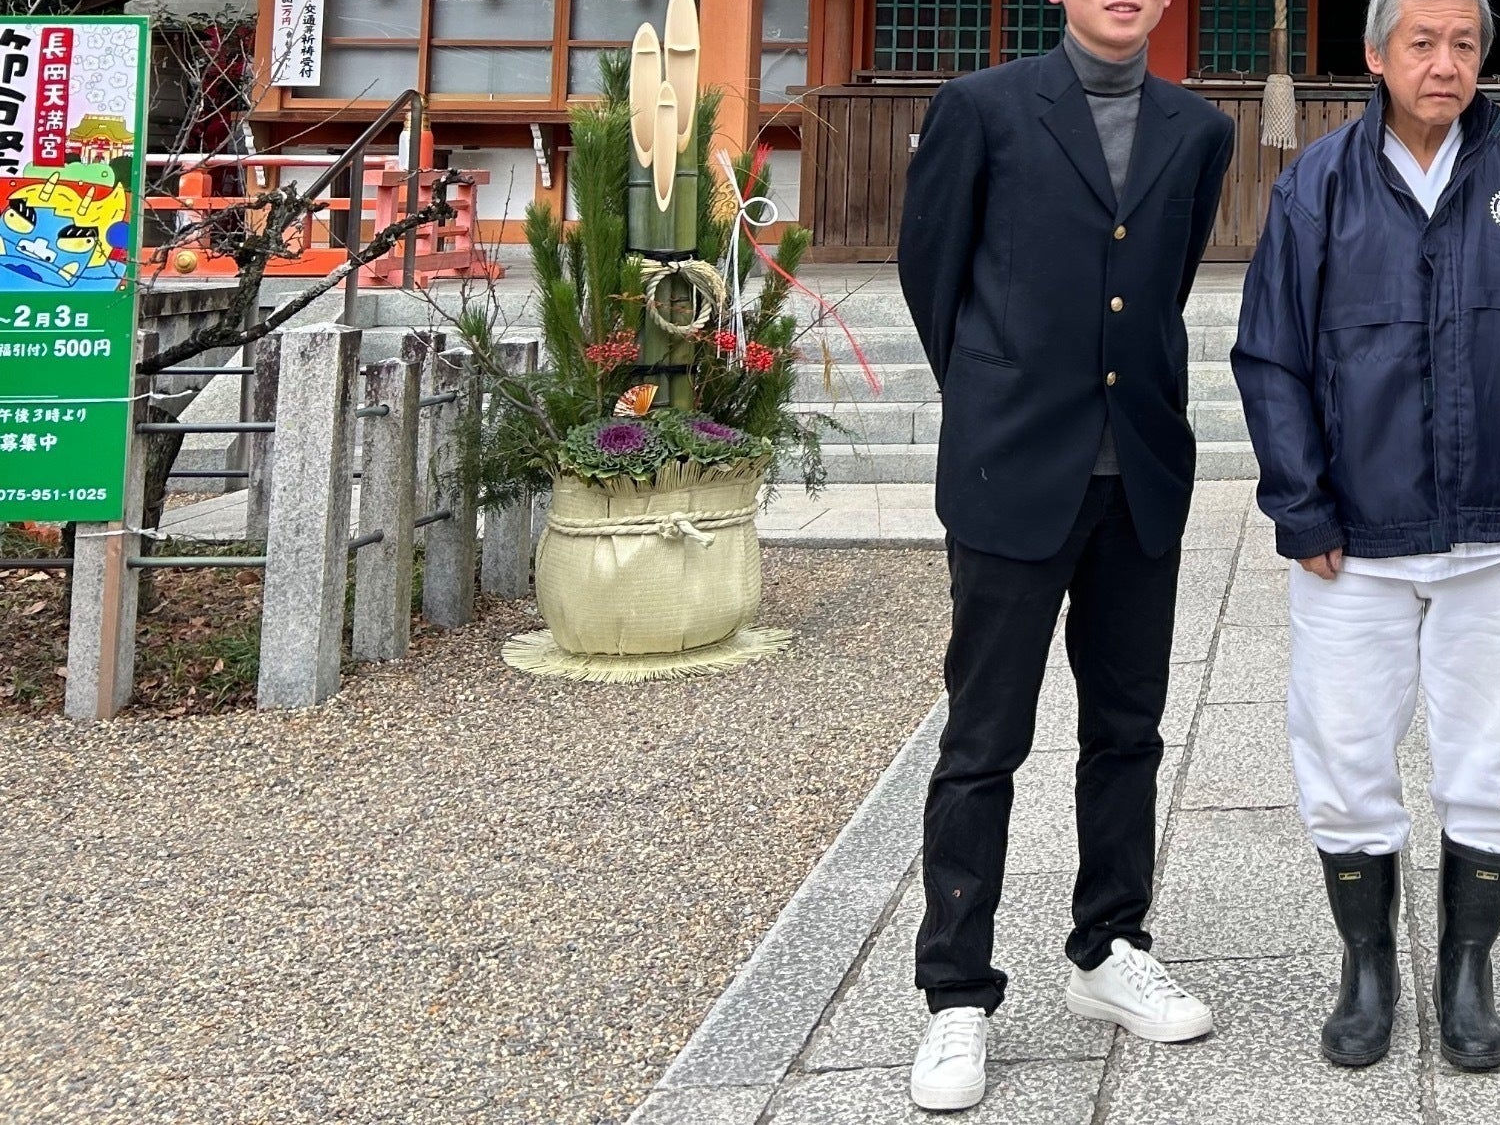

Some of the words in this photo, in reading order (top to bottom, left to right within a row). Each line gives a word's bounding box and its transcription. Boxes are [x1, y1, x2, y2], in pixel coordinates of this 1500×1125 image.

[37, 32, 67, 159] 長岡天満宮
[53, 339, 111, 357] 500円
[0, 408, 87, 423] 午後3時より
[0, 432, 58, 452] 募集中
